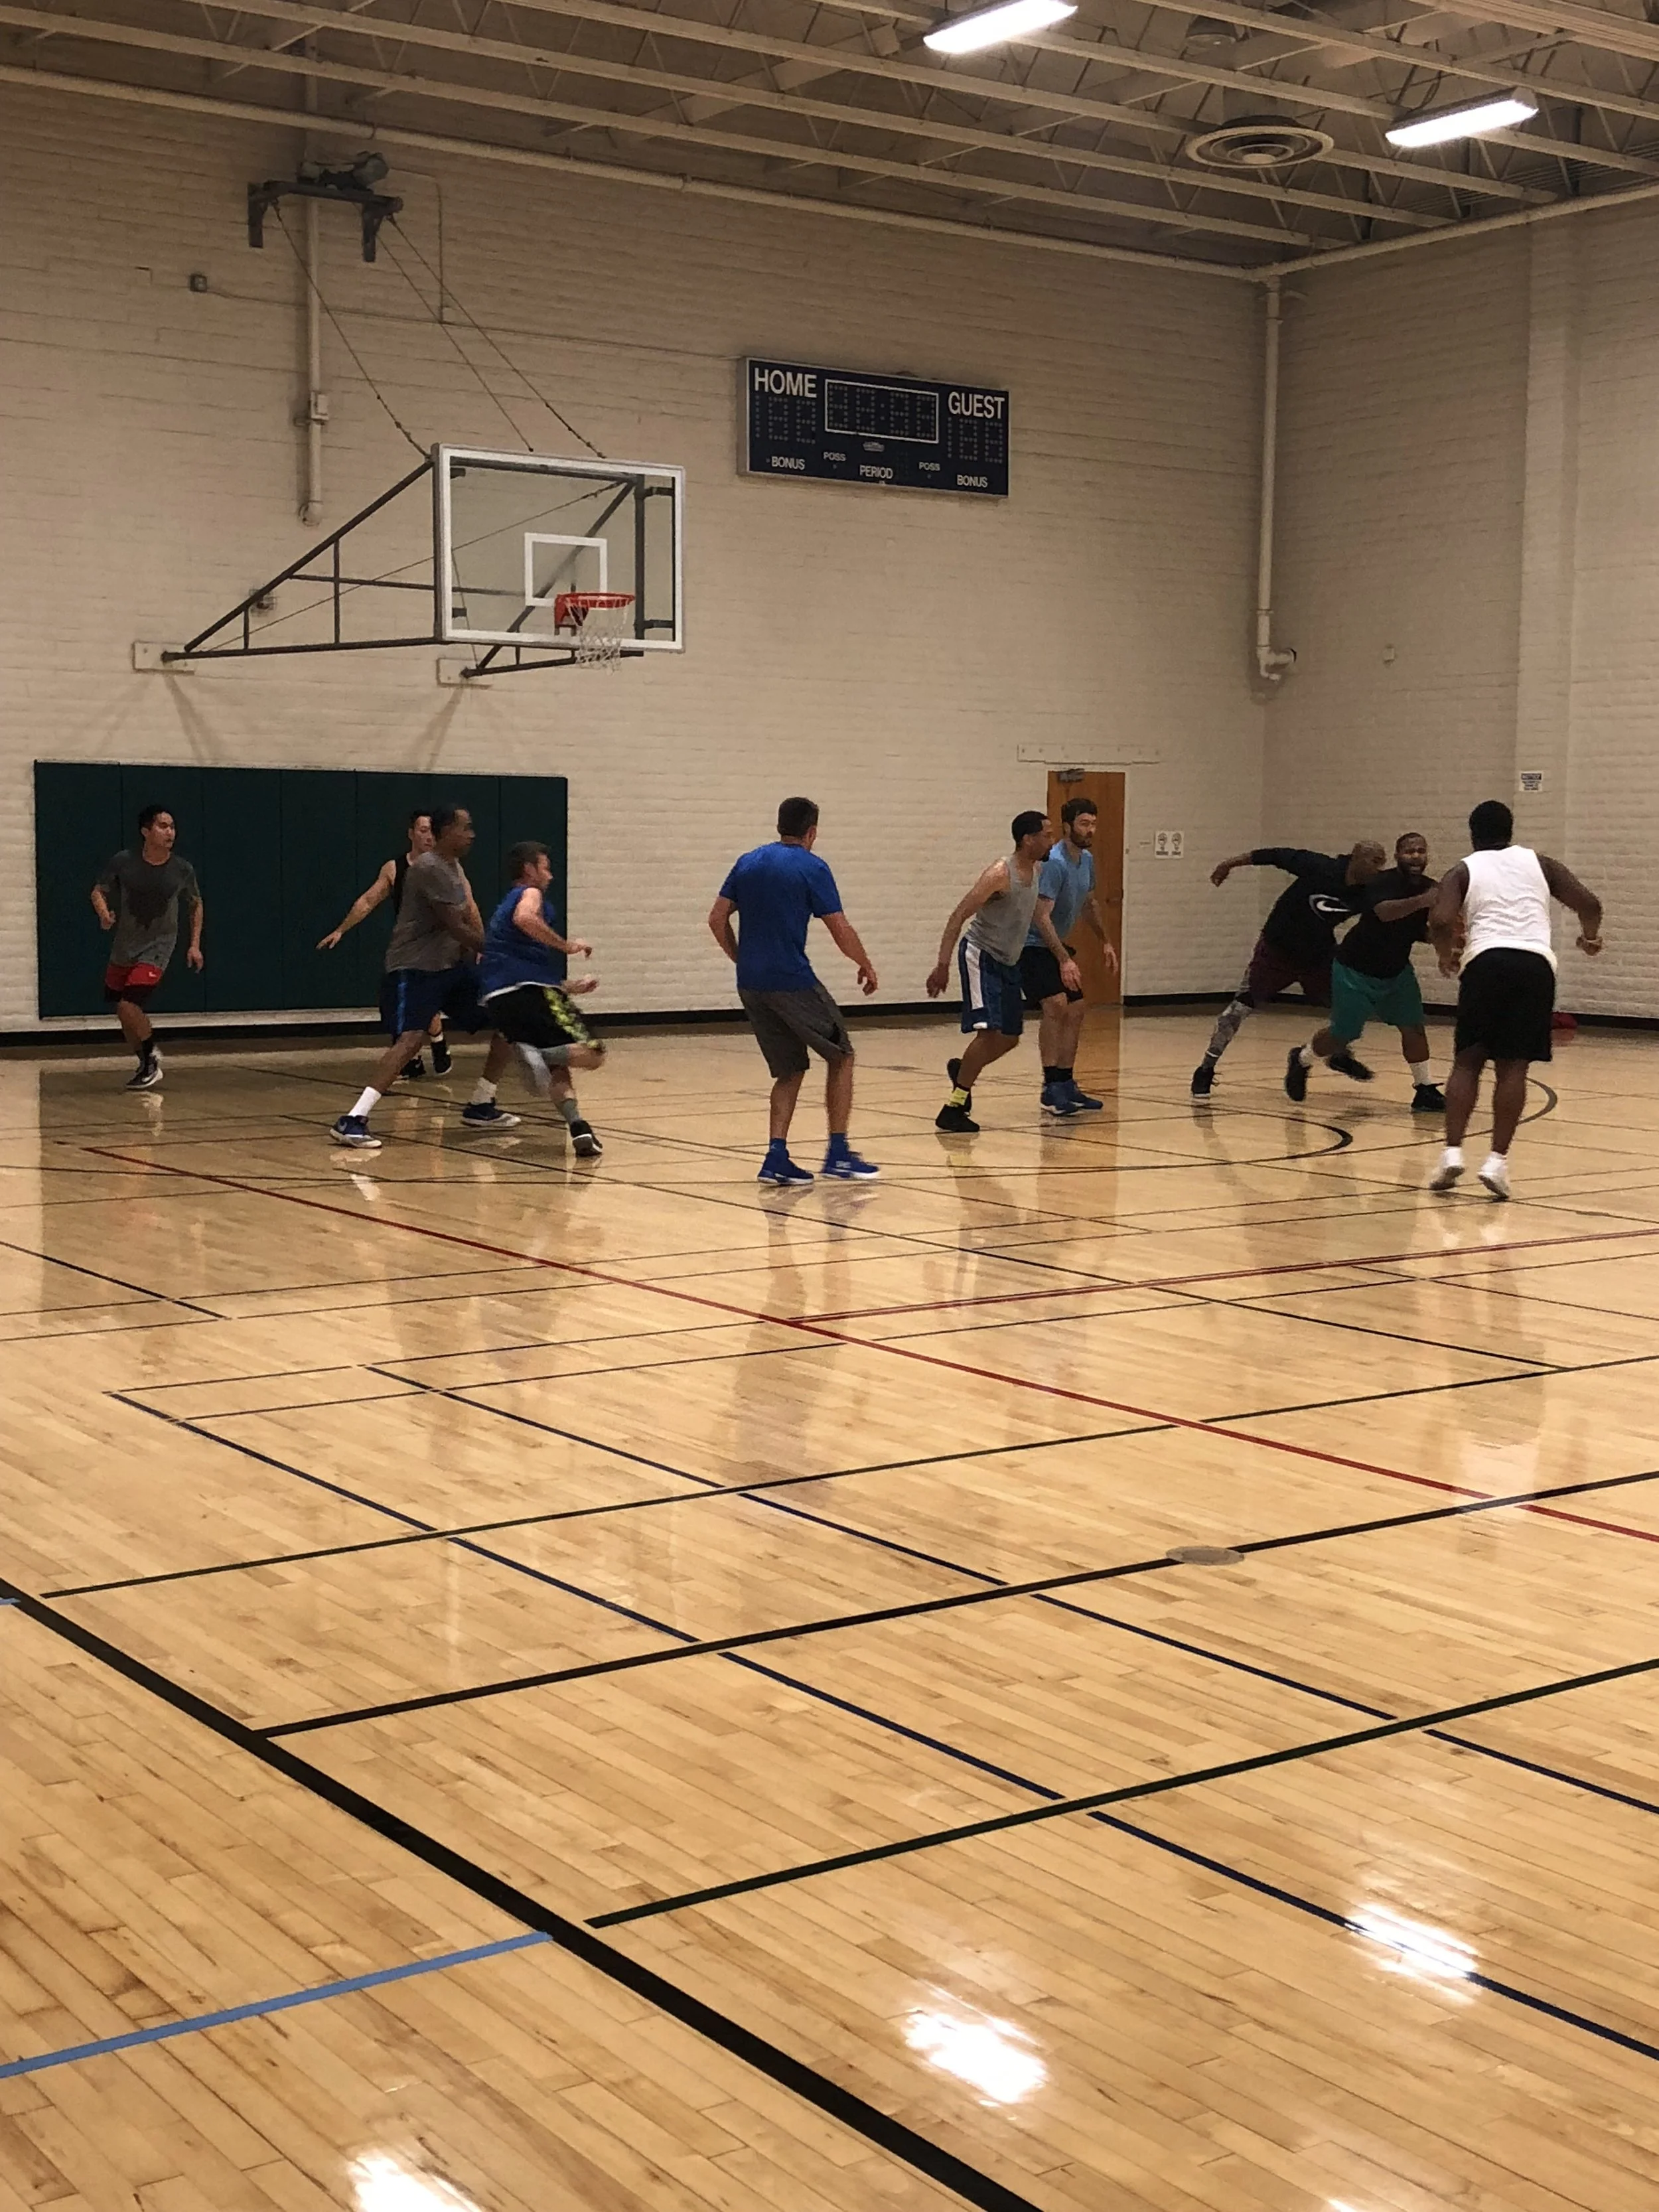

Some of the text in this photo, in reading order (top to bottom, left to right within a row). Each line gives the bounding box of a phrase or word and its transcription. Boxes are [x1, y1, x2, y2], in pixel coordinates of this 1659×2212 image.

[755, 368, 817, 398] HOME
[948, 392, 1005, 419] GUEST
[824, 451, 846, 461] POSS
[772, 457, 805, 471] BONUS
[919, 462, 940, 472] POSS
[859, 465, 893, 479] PERIOD
[957, 475, 988, 488] BONUS
